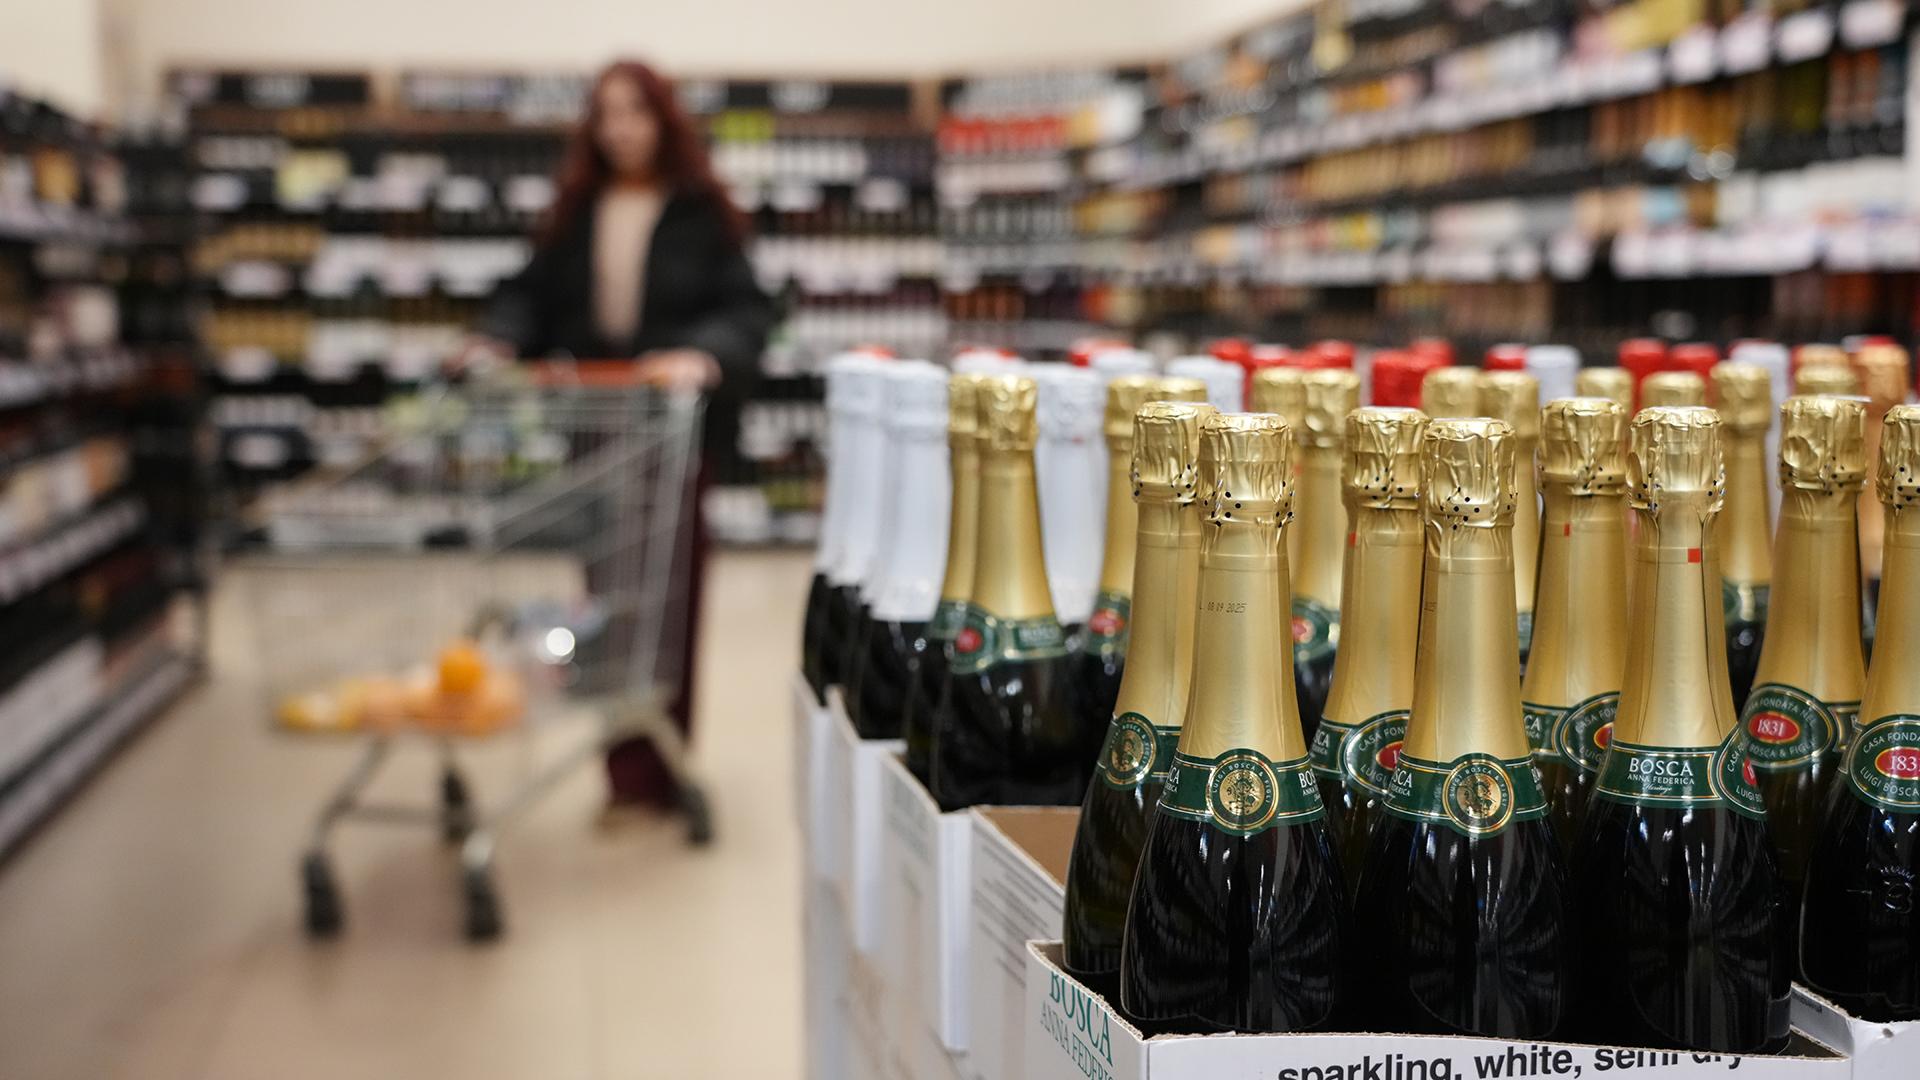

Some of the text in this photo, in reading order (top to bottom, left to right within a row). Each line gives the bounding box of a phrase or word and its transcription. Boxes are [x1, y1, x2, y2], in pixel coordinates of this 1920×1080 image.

[1359, 731, 1381, 751] CASA
[1757, 719, 1786, 737] 1831
[1863, 731, 1920, 753] CASA FONDA
[1627, 773, 1695, 786] ANNA FEDERICA
[1629, 757, 1694, 777] BOSCA
[1212, 770, 1226, 793] LUIGI
[1264, 779, 1272, 803] FIGLI
[1860, 766, 1920, 797] LUIGI BOSCA
[1040, 1000, 1071, 1055] ANNA
[1049, 971, 1113, 1067] BOSCA
[1474, 1044, 1582, 1079] white,
